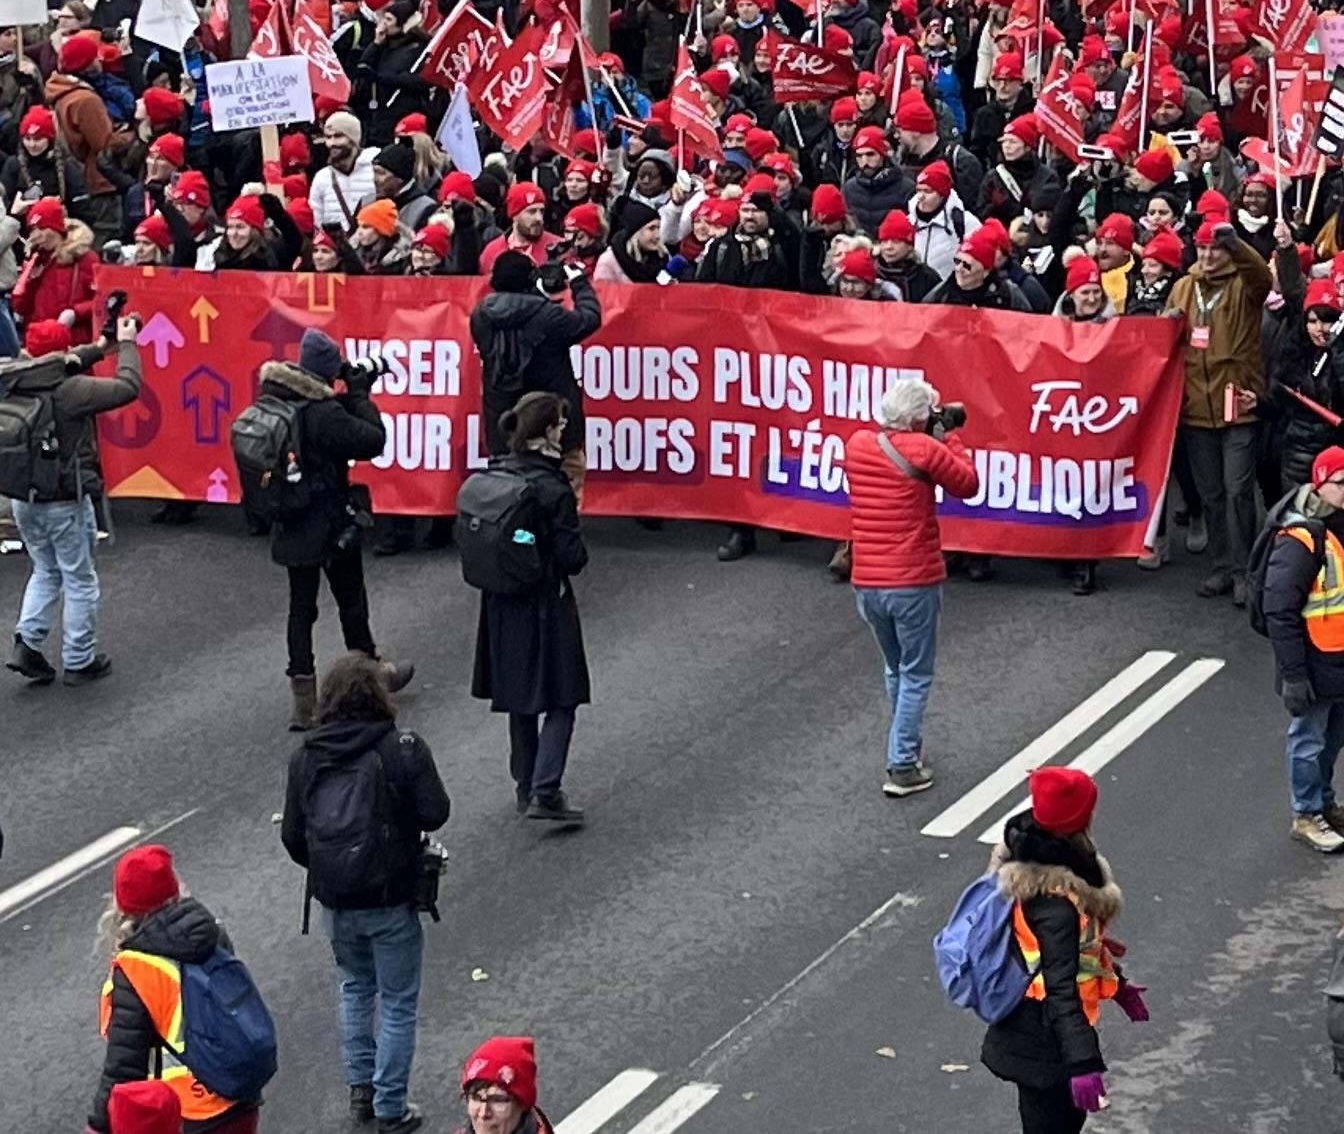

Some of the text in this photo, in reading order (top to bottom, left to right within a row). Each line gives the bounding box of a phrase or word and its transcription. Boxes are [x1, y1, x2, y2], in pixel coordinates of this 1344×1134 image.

[345, 338, 461, 396] VISER
[713, 346, 814, 413] PLUS
[348, 412, 453, 471] OUR
[585, 417, 695, 474] ROFS
[710, 420, 757, 478] ET
[767, 418, 851, 494] L'ÉC
[935, 448, 1138, 519] UBLIQUE
